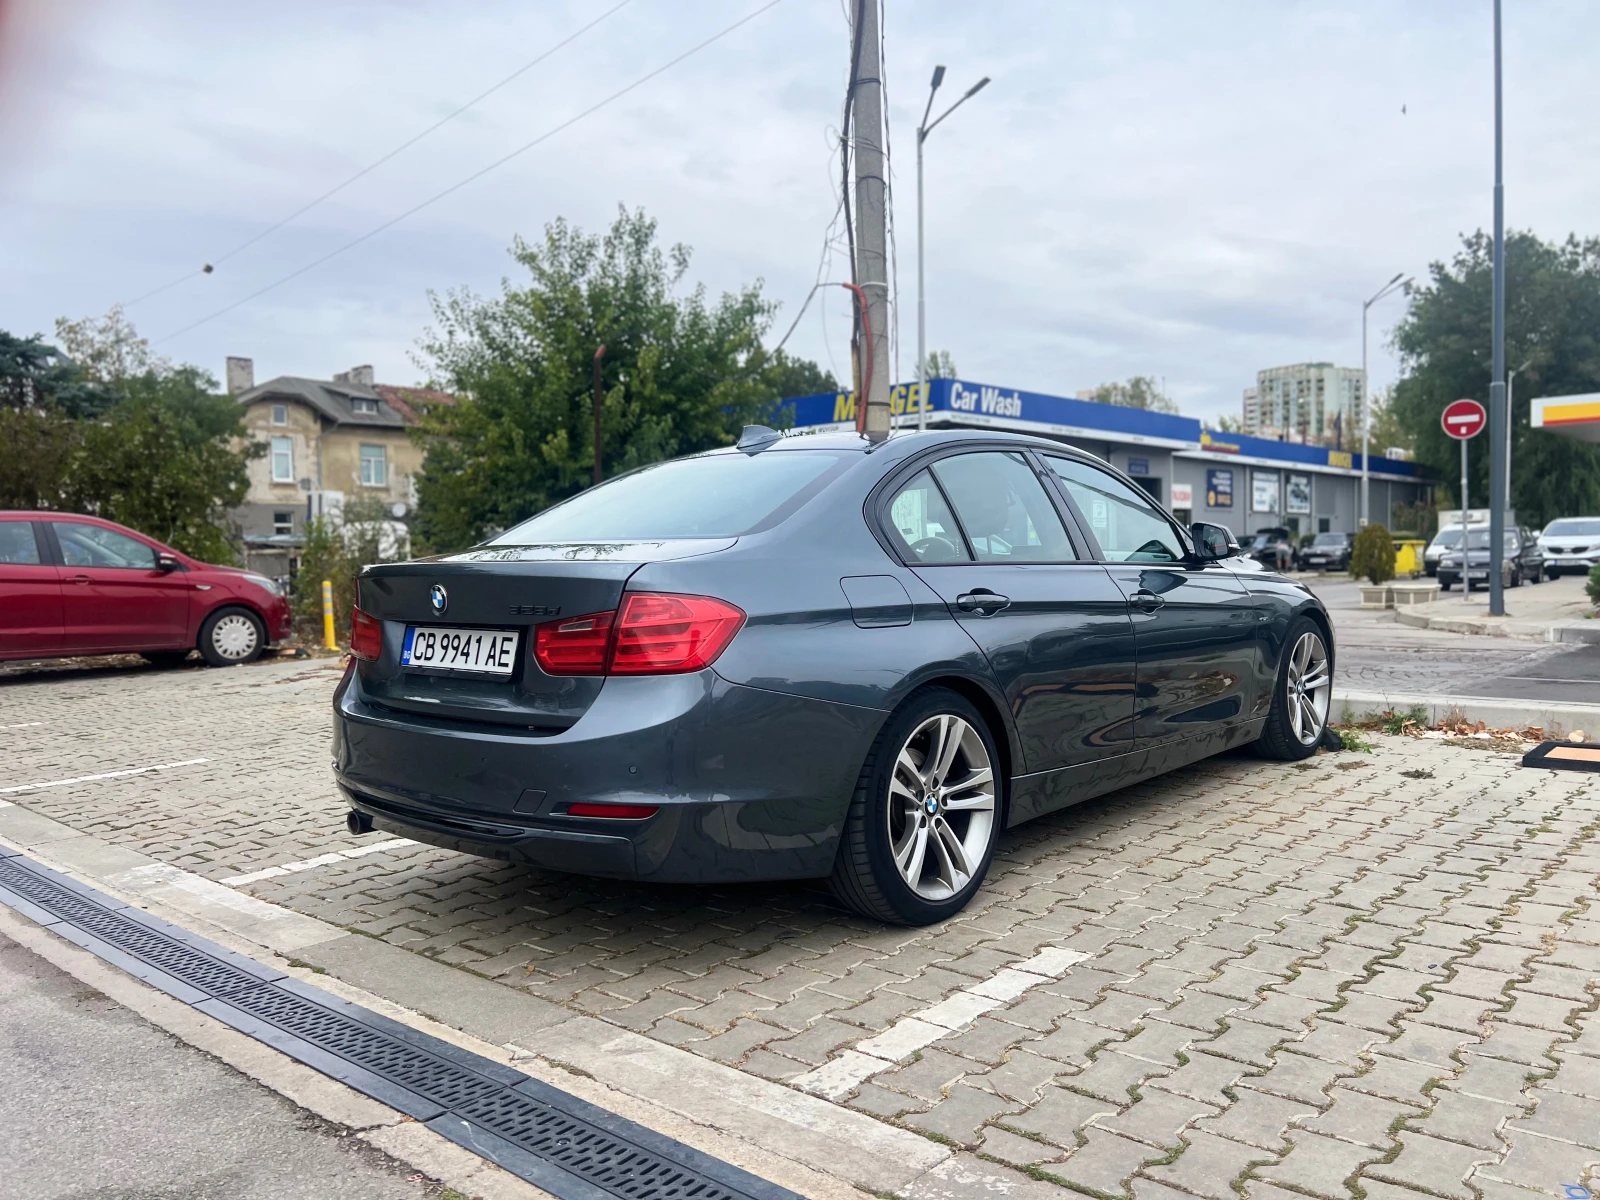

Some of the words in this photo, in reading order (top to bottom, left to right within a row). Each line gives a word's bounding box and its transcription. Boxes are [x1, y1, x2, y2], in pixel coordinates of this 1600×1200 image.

[833, 383, 934, 422] MGEL
[951, 382, 978, 411] Car
[981, 387, 1022, 418] Wash
[403, 650, 411, 659] BG
